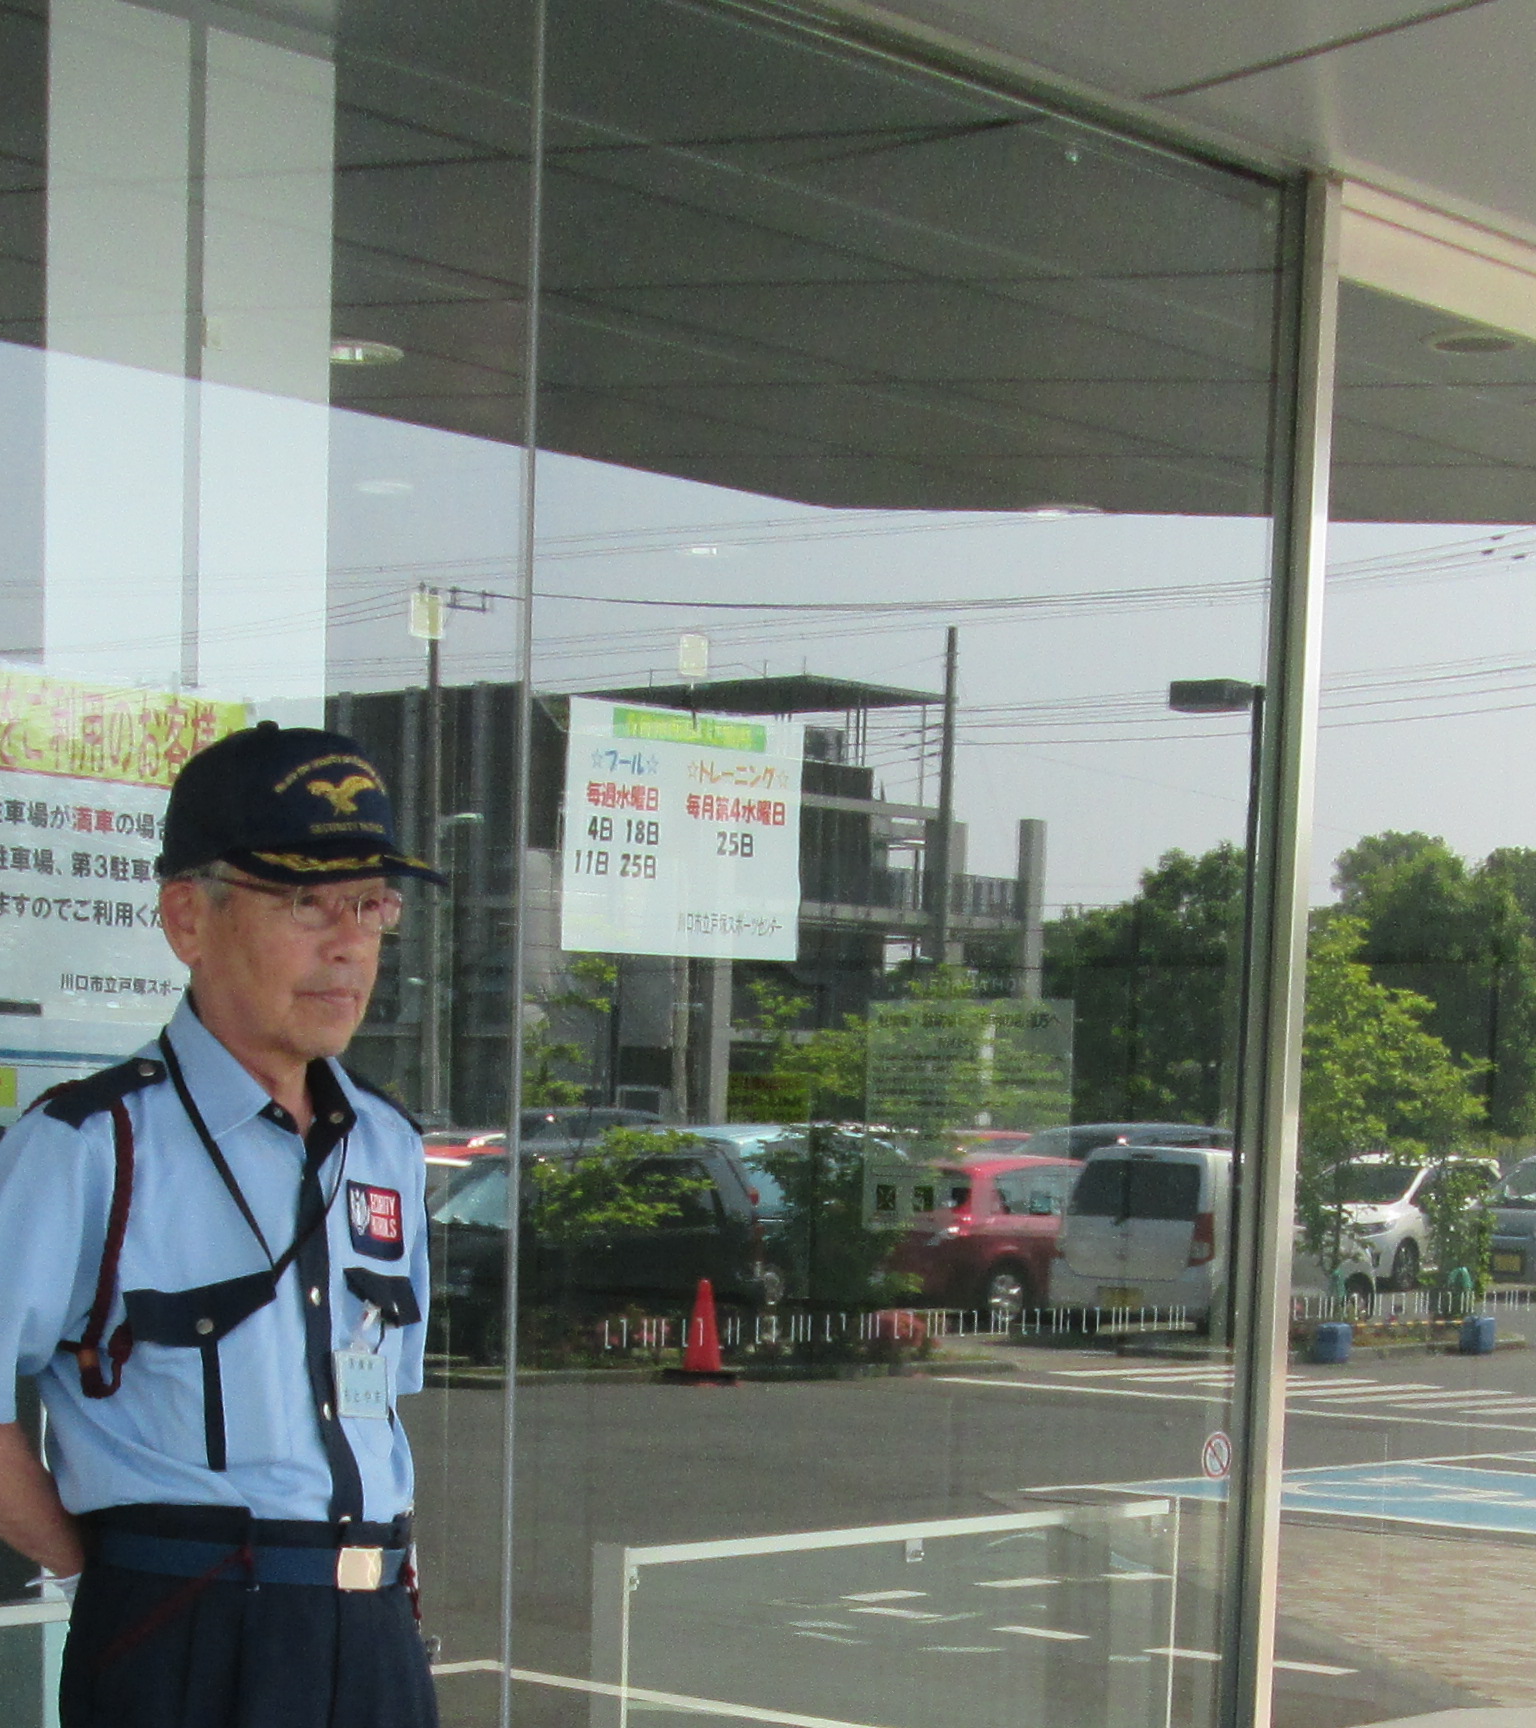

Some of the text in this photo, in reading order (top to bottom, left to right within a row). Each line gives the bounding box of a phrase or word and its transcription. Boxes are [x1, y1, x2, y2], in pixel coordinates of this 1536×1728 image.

[587, 781, 659, 811] 毎週水曜日
[686, 793, 785, 826] 毎月第4水曜日
[588, 816, 659, 845] 4日 18日
[717, 831, 753, 857] 25日
[575, 850, 656, 879] 11日 25日
